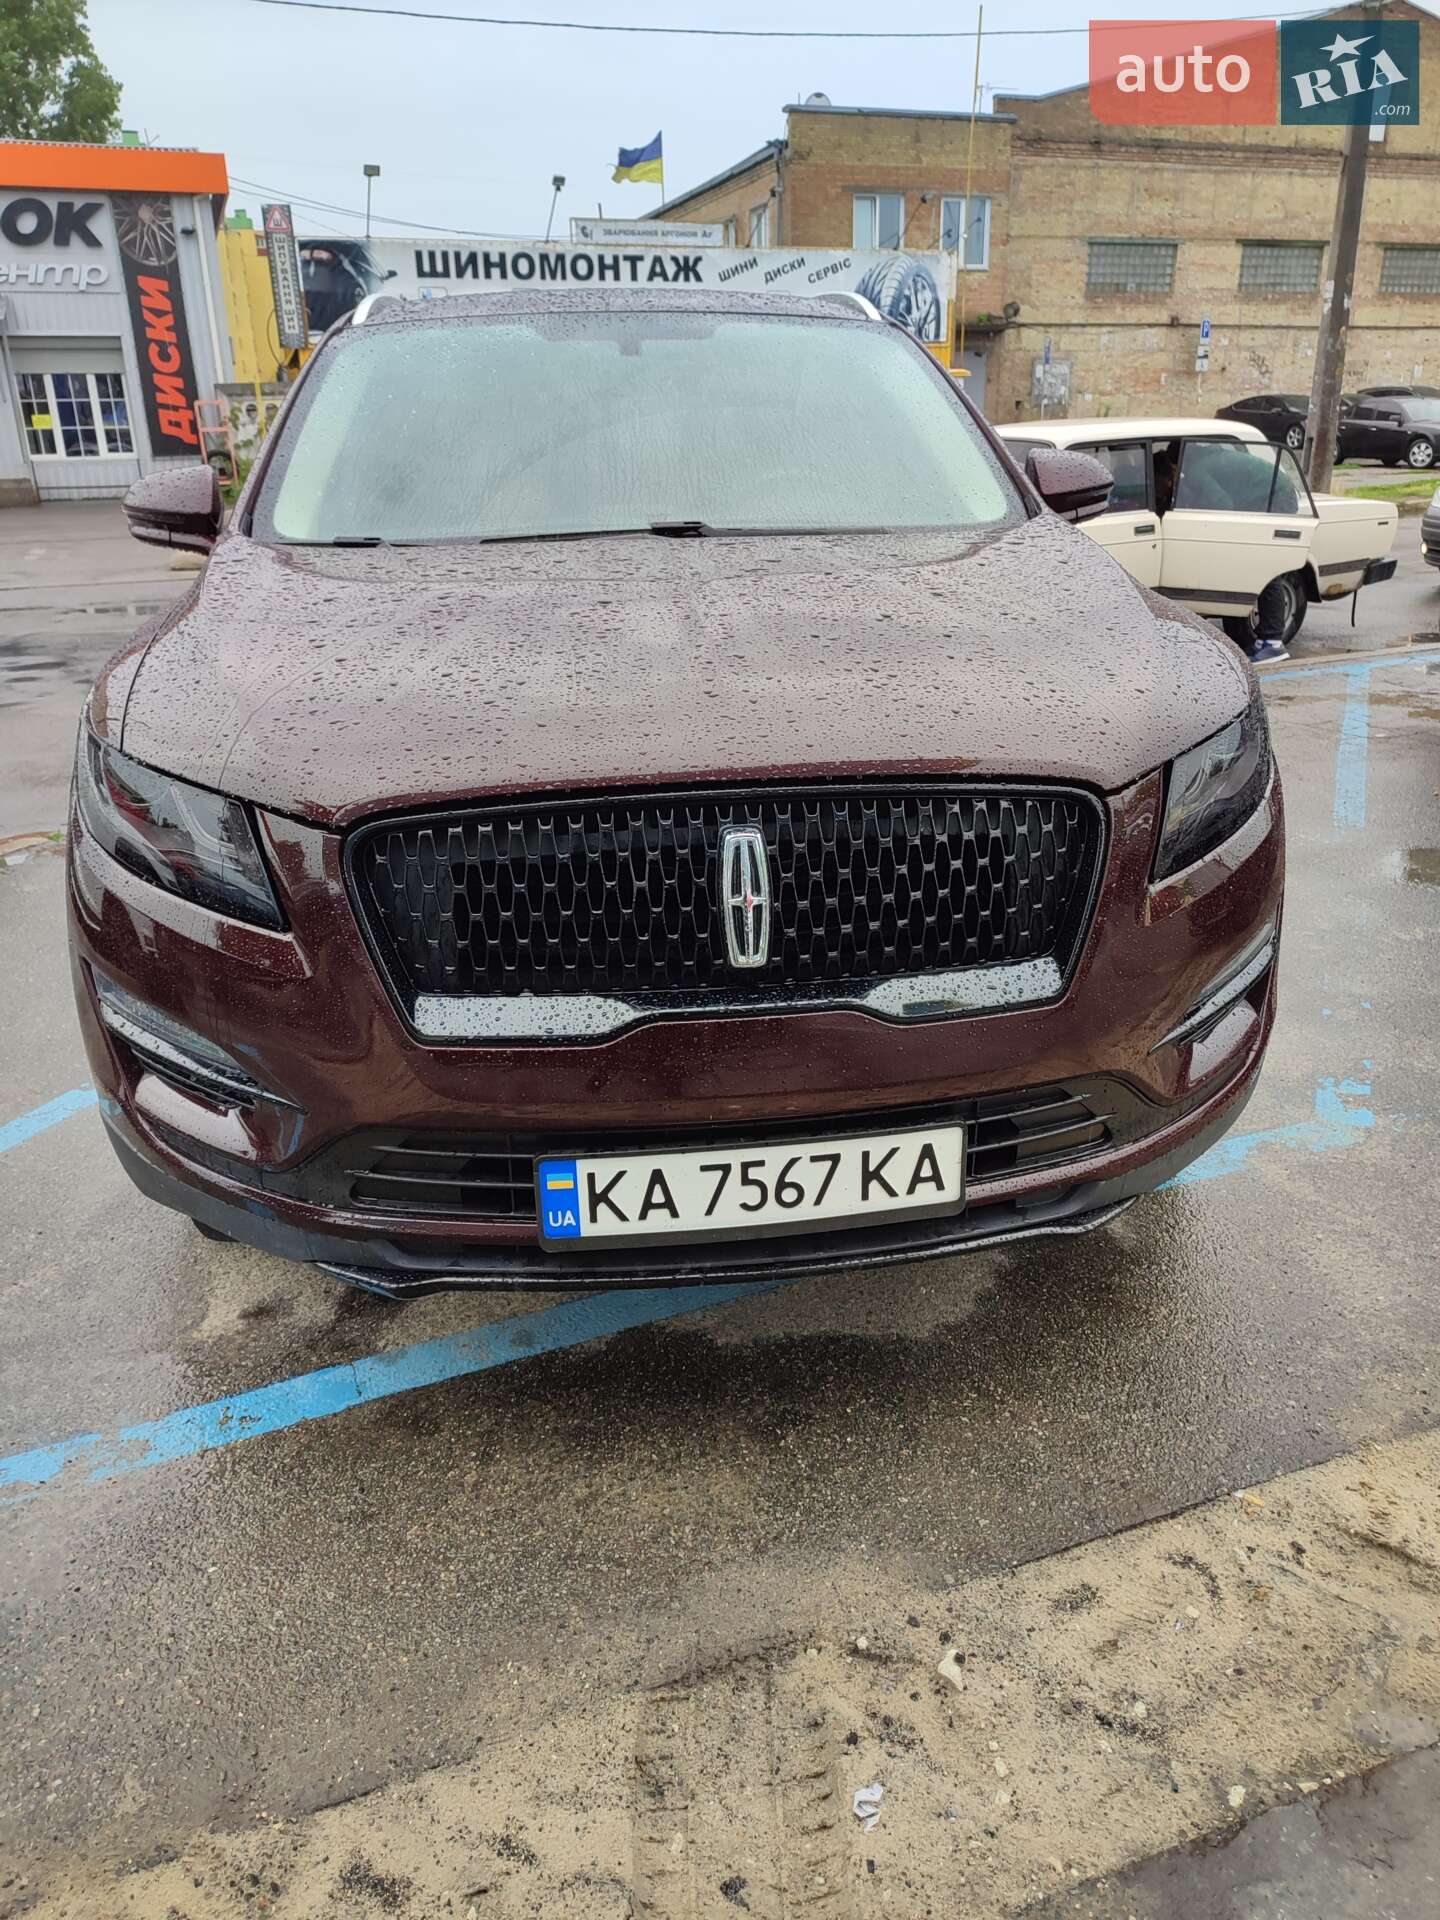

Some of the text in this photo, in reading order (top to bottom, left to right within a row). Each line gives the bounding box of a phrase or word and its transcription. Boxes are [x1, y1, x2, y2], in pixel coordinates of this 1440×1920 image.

[414, 249, 704, 283] ШИНОМОНТАЖ
[718, 256, 759, 283] ШИНИ
[764, 257, 807, 285] ДИСКИ
[807, 257, 852, 285] СЕРВІС
[137, 275, 198, 445] ДИСКИ
[586, 1142, 946, 1224] KA 7567 KA
[549, 1209, 577, 1228] UA
